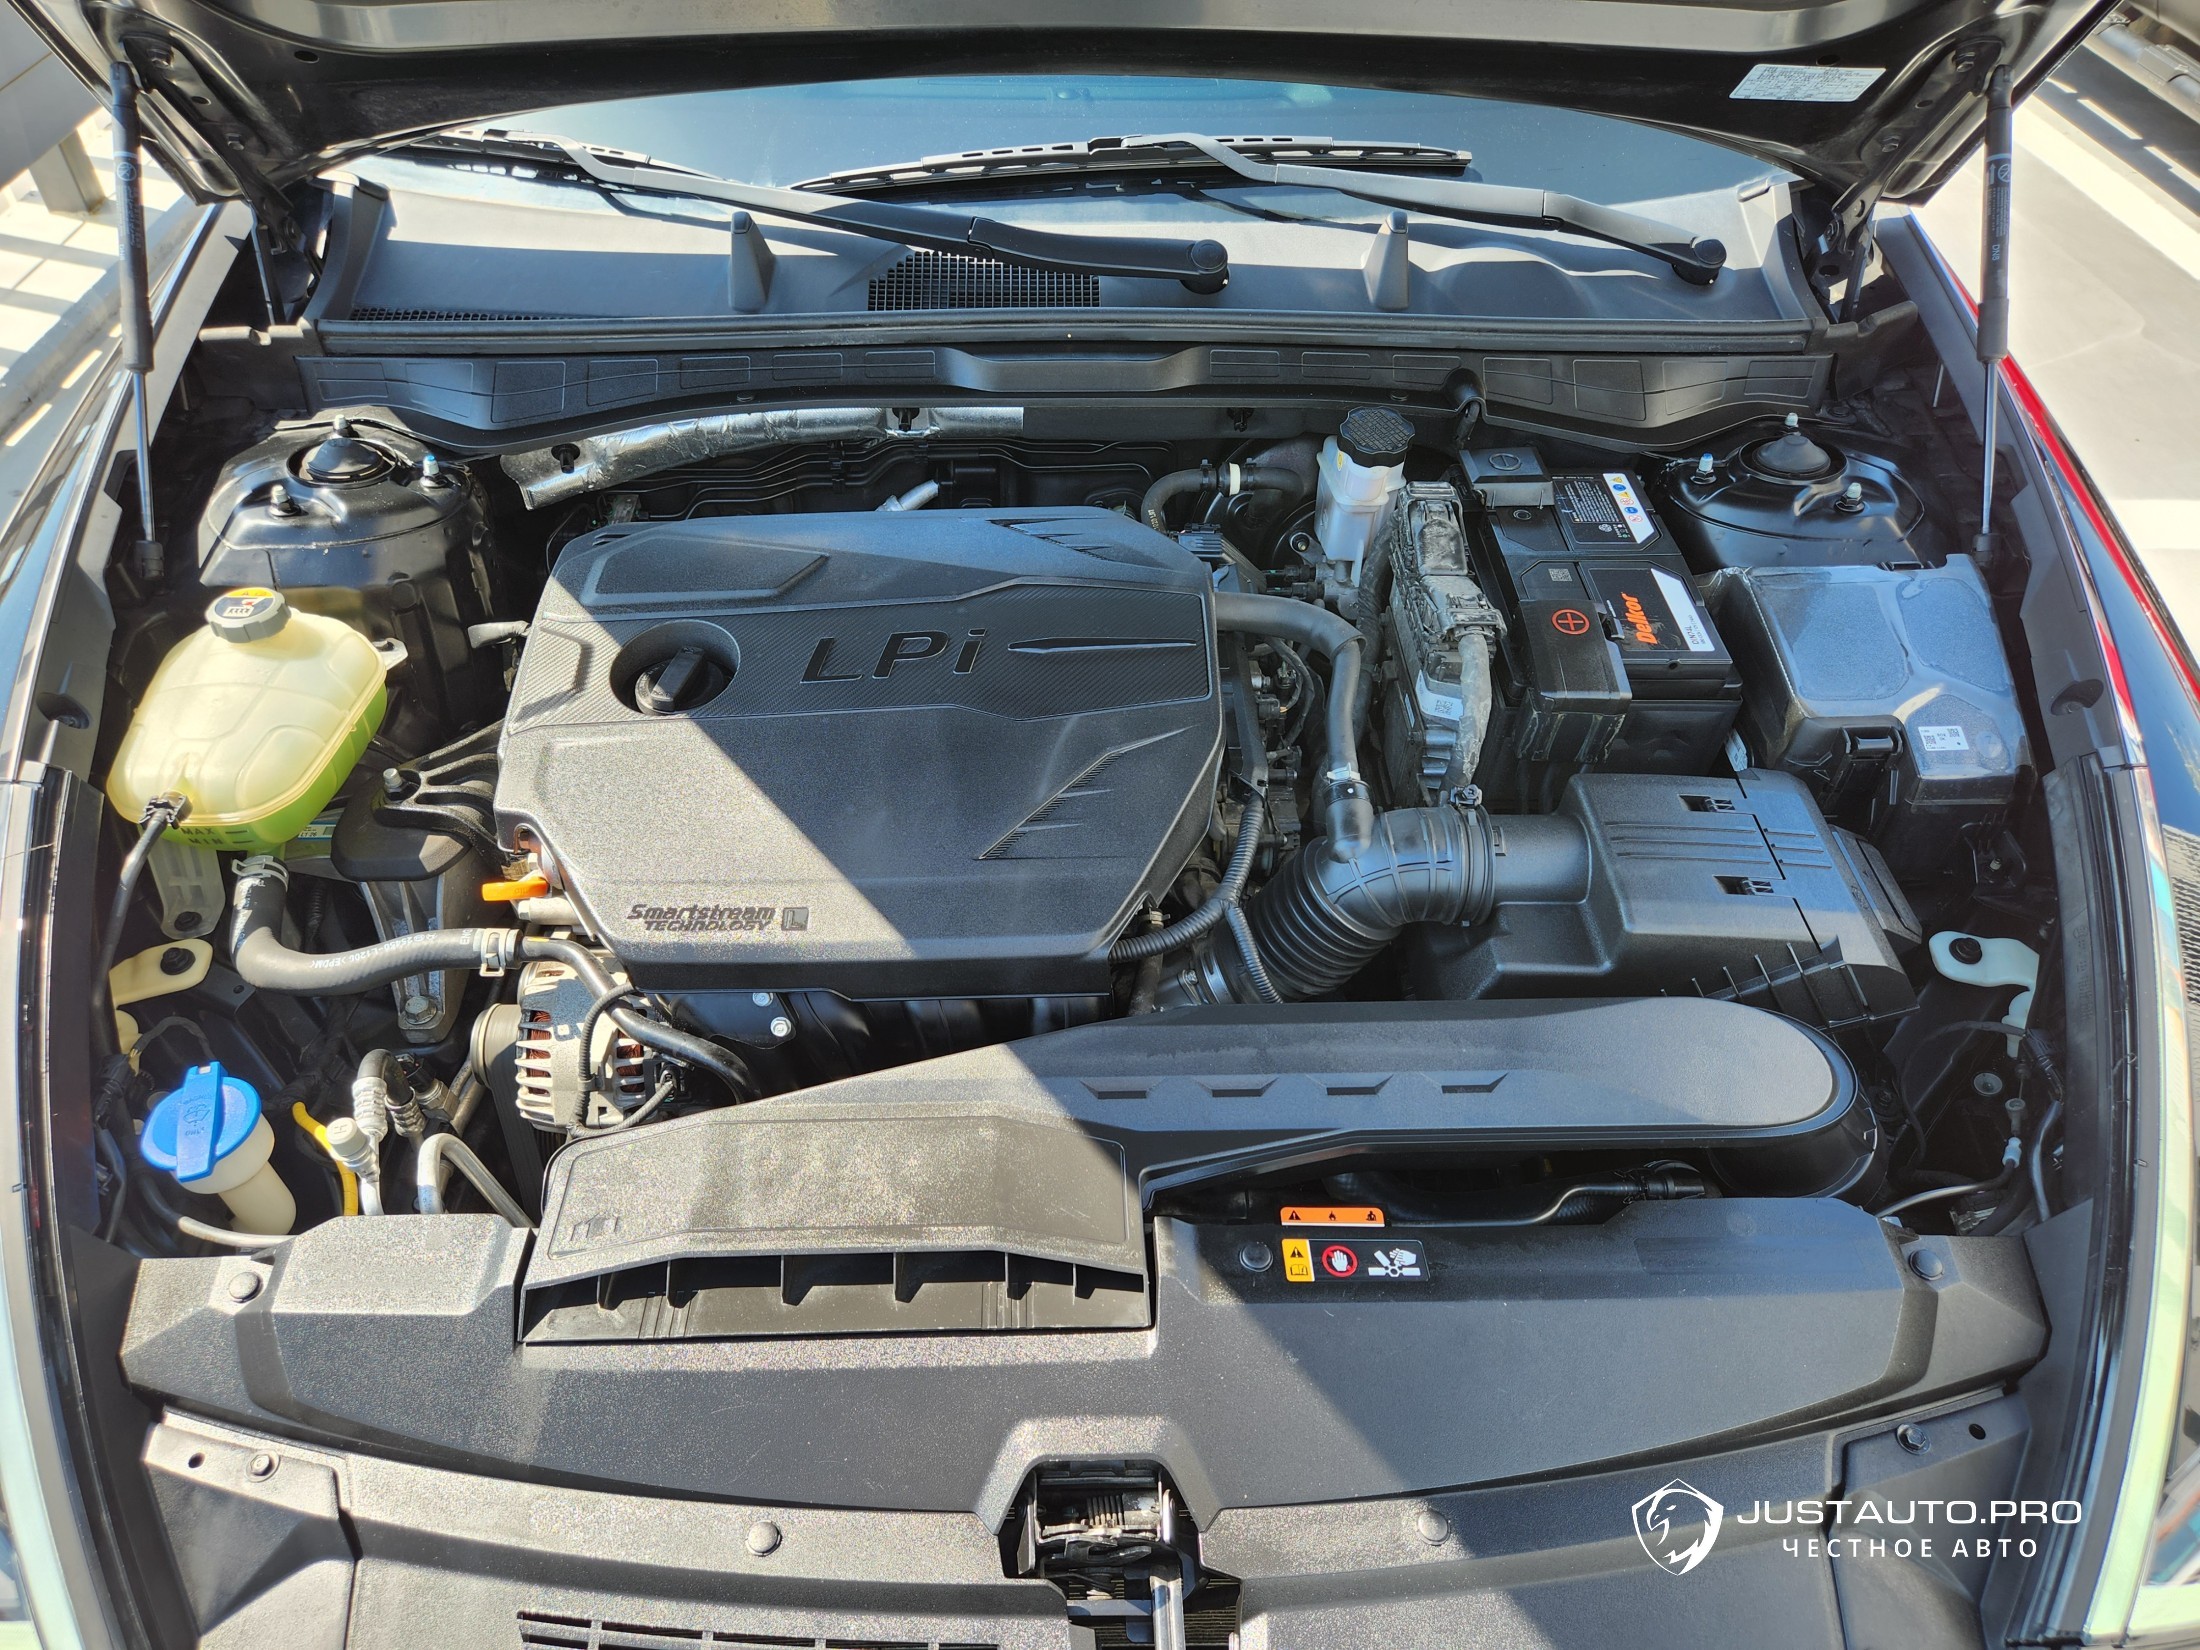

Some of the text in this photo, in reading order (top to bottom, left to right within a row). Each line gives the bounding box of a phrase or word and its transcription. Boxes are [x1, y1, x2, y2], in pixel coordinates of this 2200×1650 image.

[1991, 244, 2001, 261] DN8
[1620, 591, 1658, 645] Delkor
[800, 628, 987, 683] LPi
[180, 827, 215, 835] MAX
[626, 903, 777, 921] Smartstream
[644, 920, 772, 932] TECHNOLOGY
